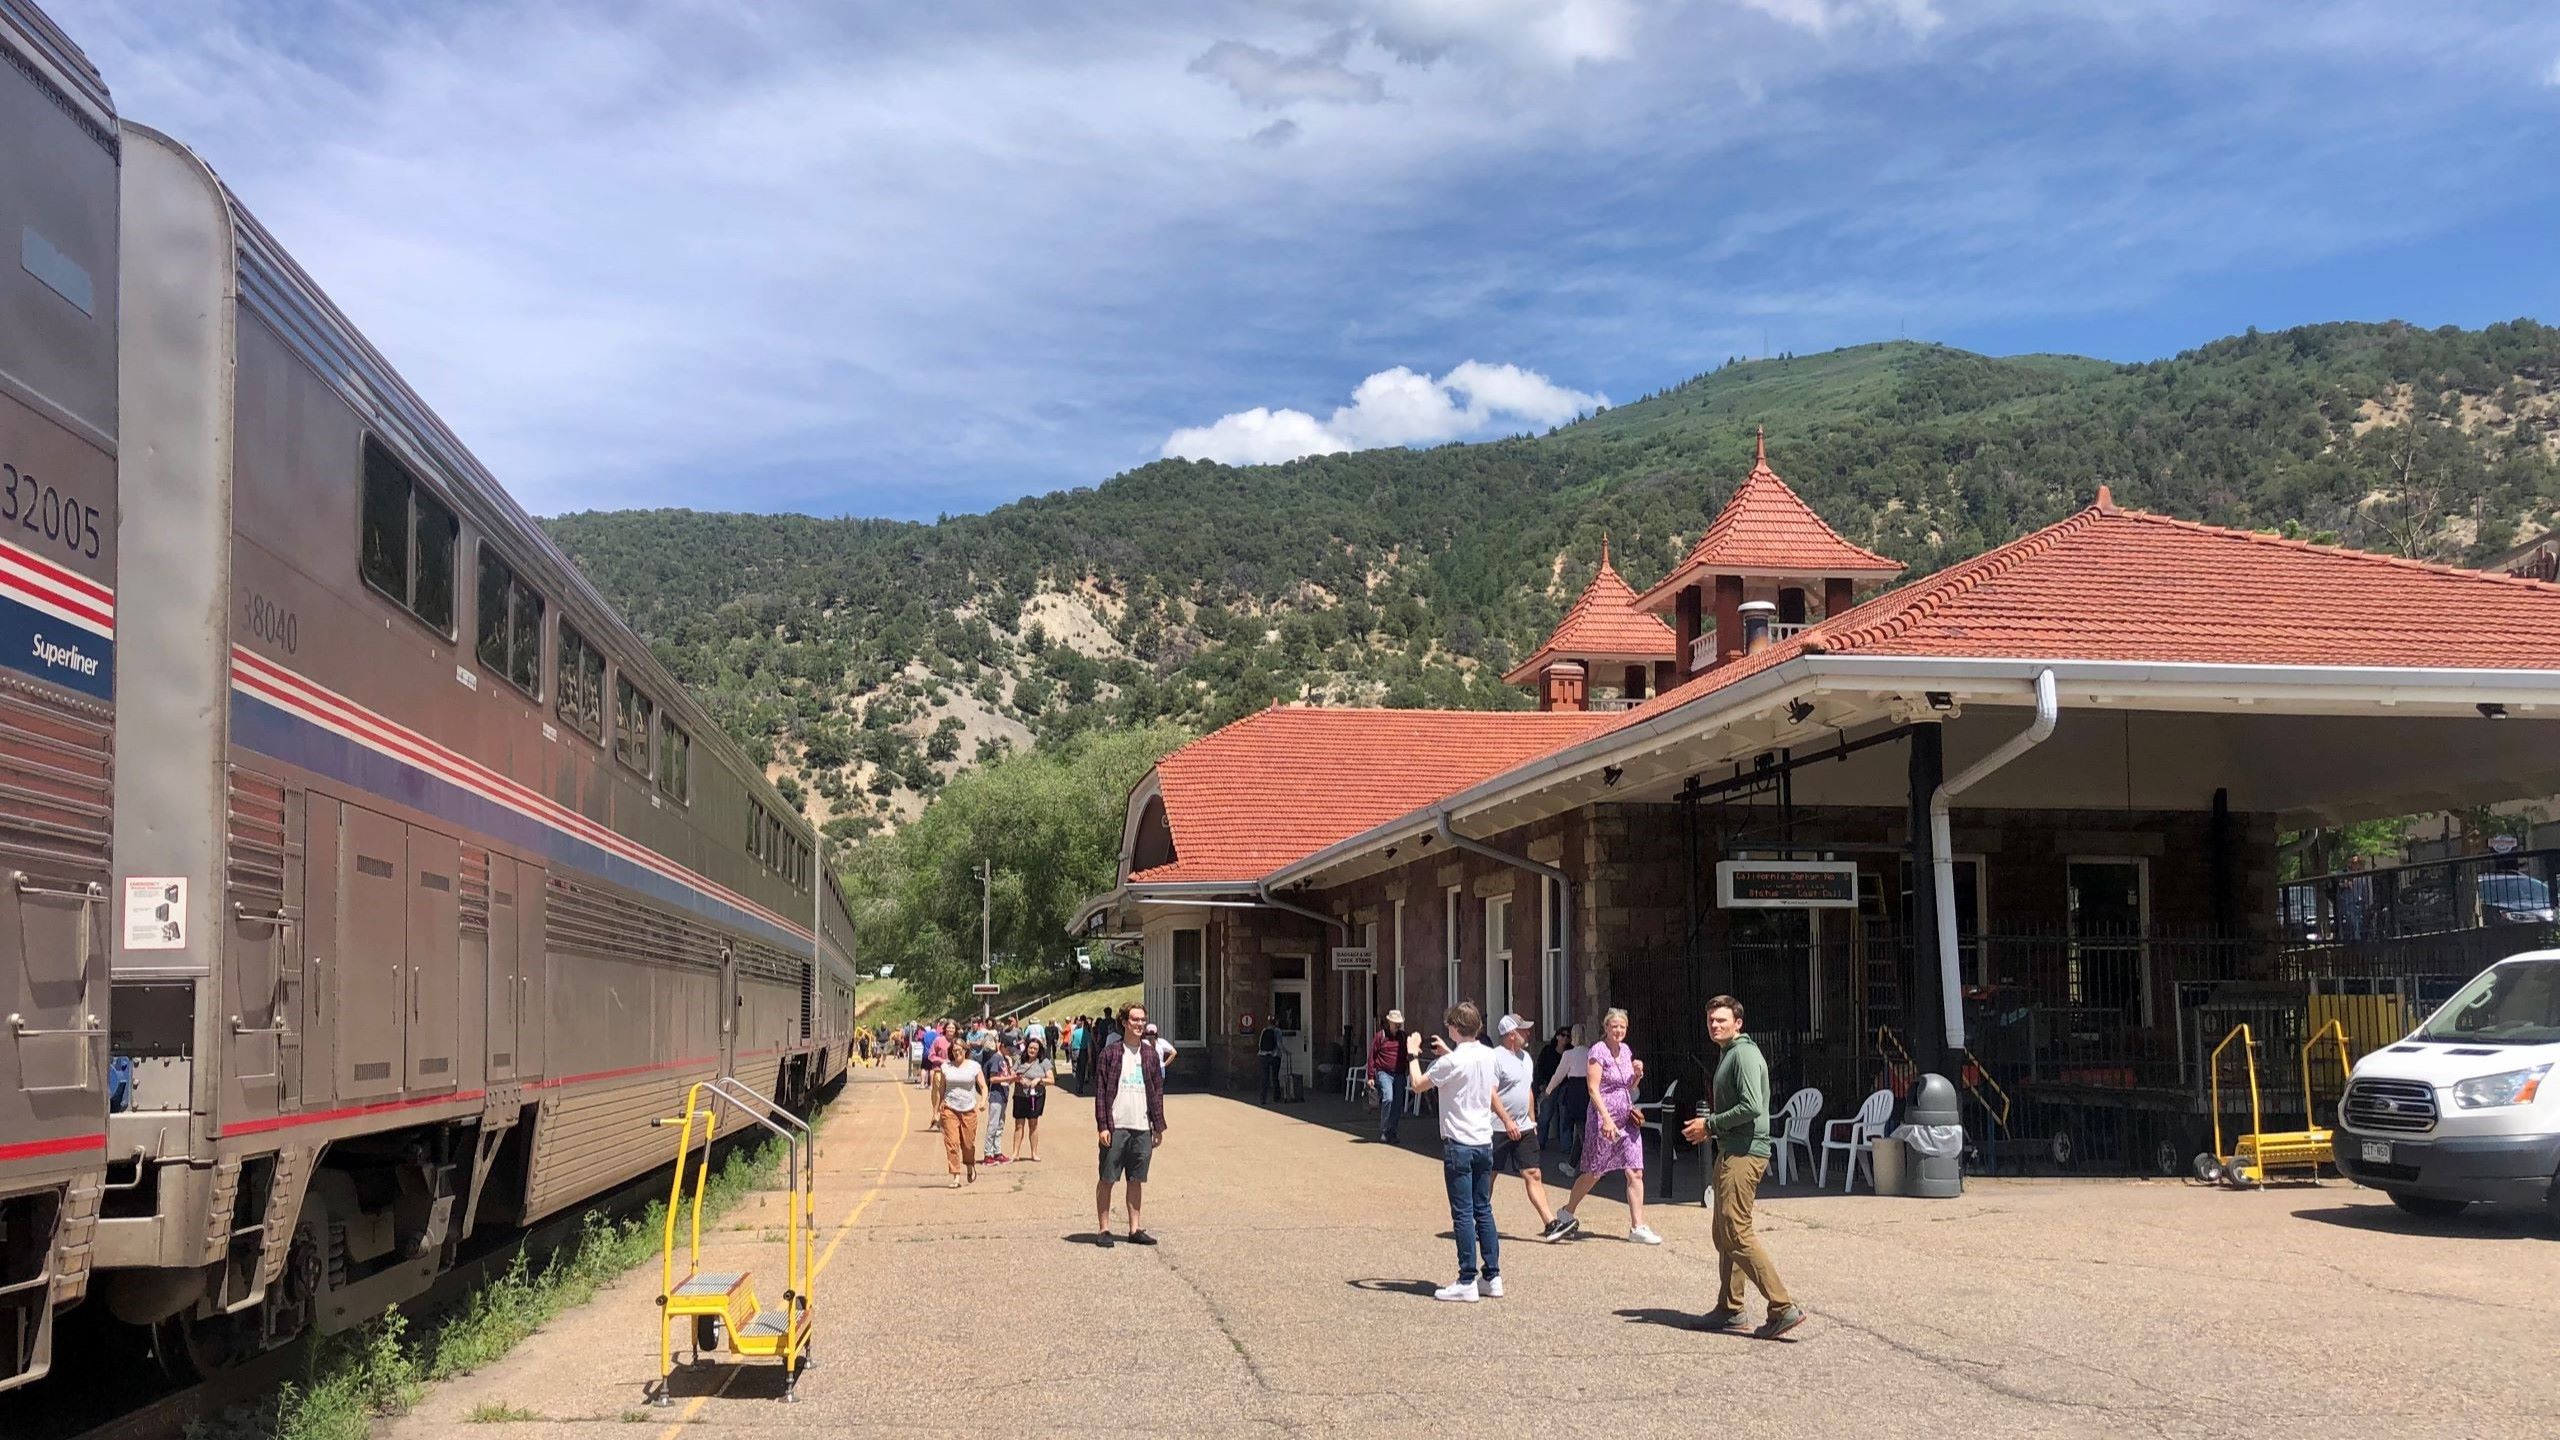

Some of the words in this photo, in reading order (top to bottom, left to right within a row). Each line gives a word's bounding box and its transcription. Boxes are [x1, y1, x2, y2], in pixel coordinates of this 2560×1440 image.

[2, 463, 100, 559] 32005
[241, 586, 297, 655] 38040
[32, 633, 99, 677] Superliner
[1735, 872, 1786, 880] California
[1749, 889, 1779, 898] Status
[1797, 889, 1818, 898] Last
